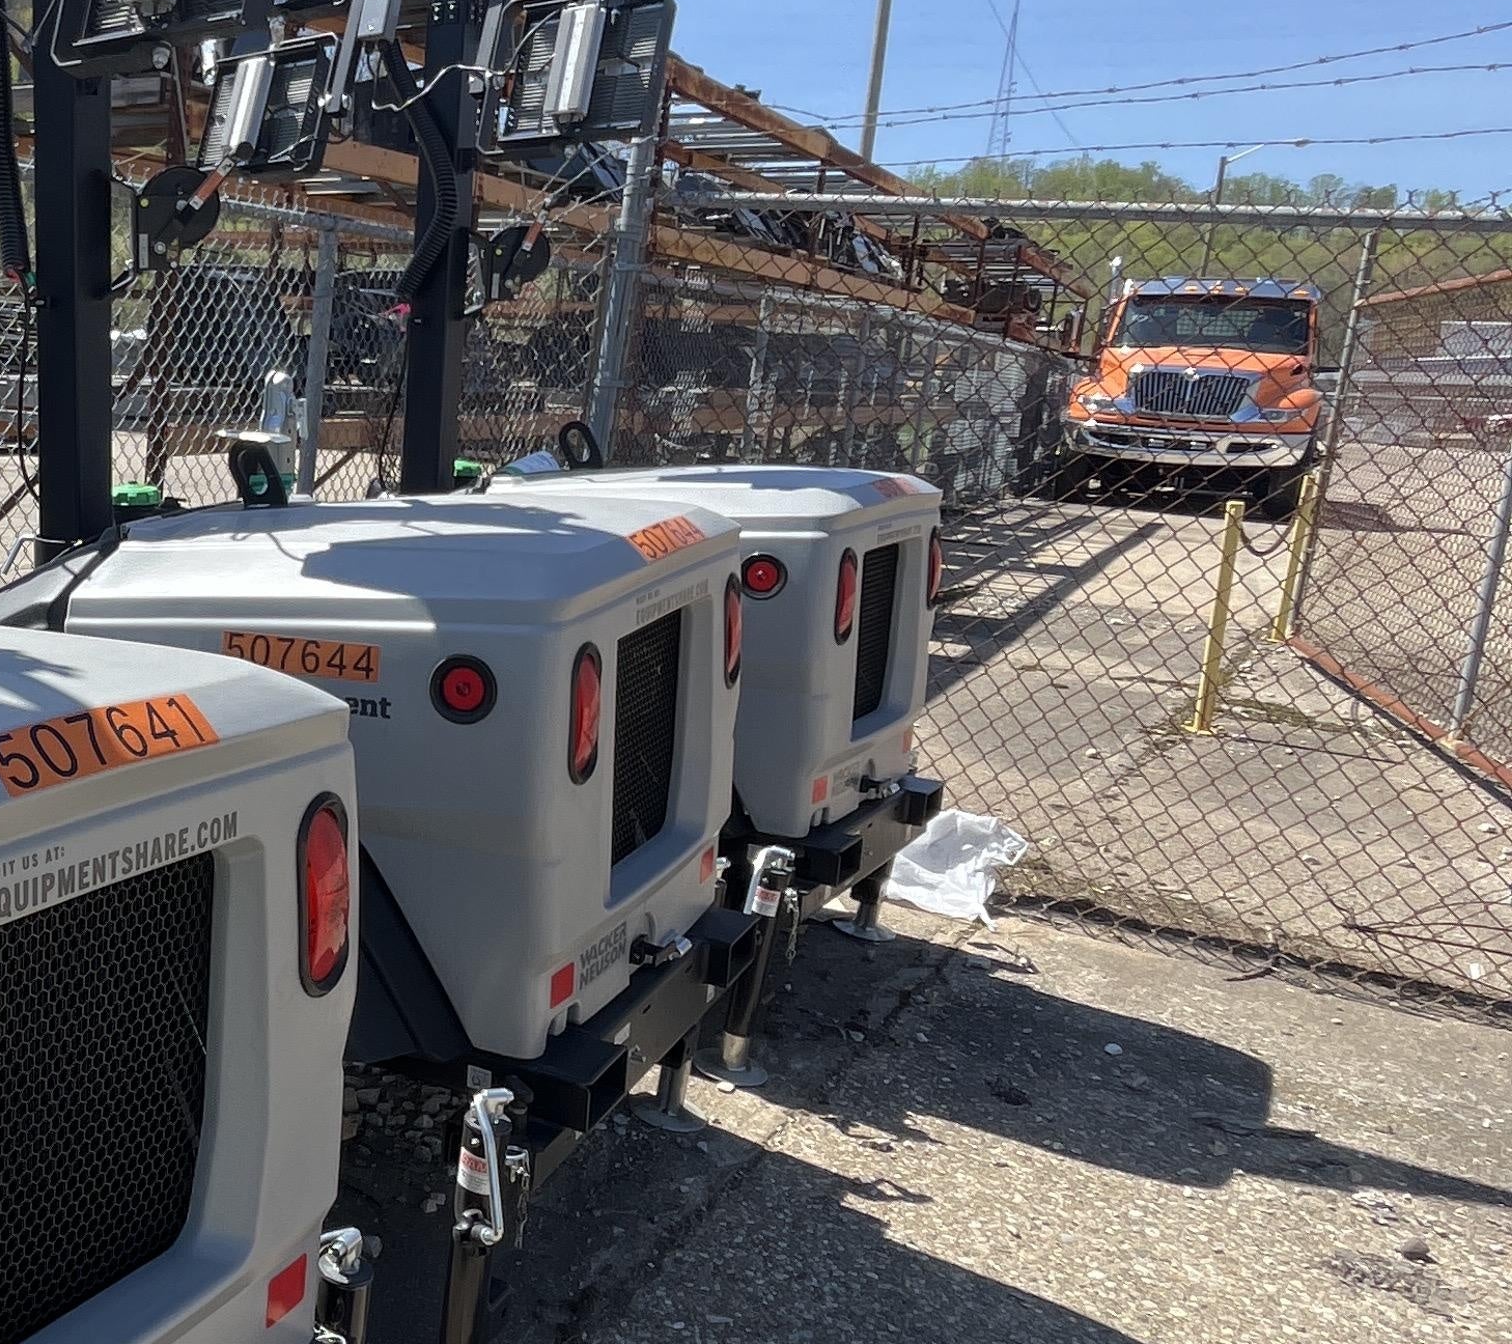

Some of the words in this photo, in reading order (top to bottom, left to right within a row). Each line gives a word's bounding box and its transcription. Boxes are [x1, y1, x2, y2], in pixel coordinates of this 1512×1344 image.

[226, 632, 375, 680] 507644
[22, 853, 39, 871] US
[45, 845, 65, 865] AT:
